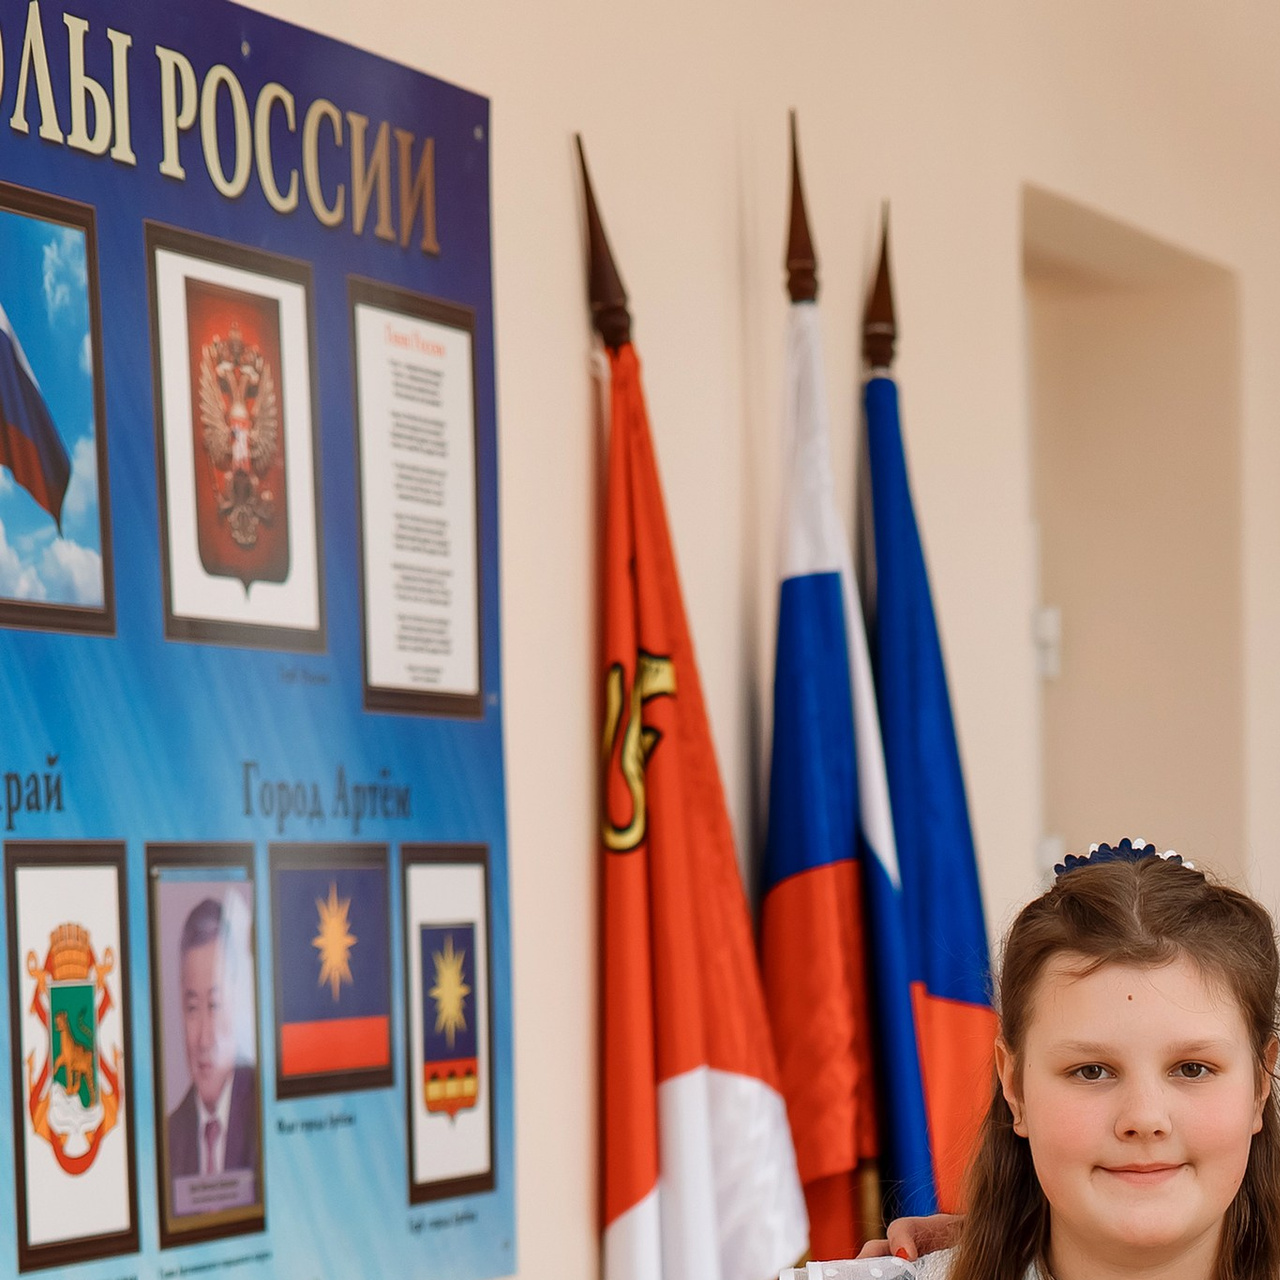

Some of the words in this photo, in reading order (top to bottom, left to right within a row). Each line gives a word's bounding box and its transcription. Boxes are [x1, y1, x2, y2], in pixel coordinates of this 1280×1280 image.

[0, 0, 138, 167] ЛЫ
[155, 44, 441, 256] РОССИИ
[0, 753, 64, 831] рай
[242, 761, 326, 835] Город
[332, 764, 412, 836] Артём
